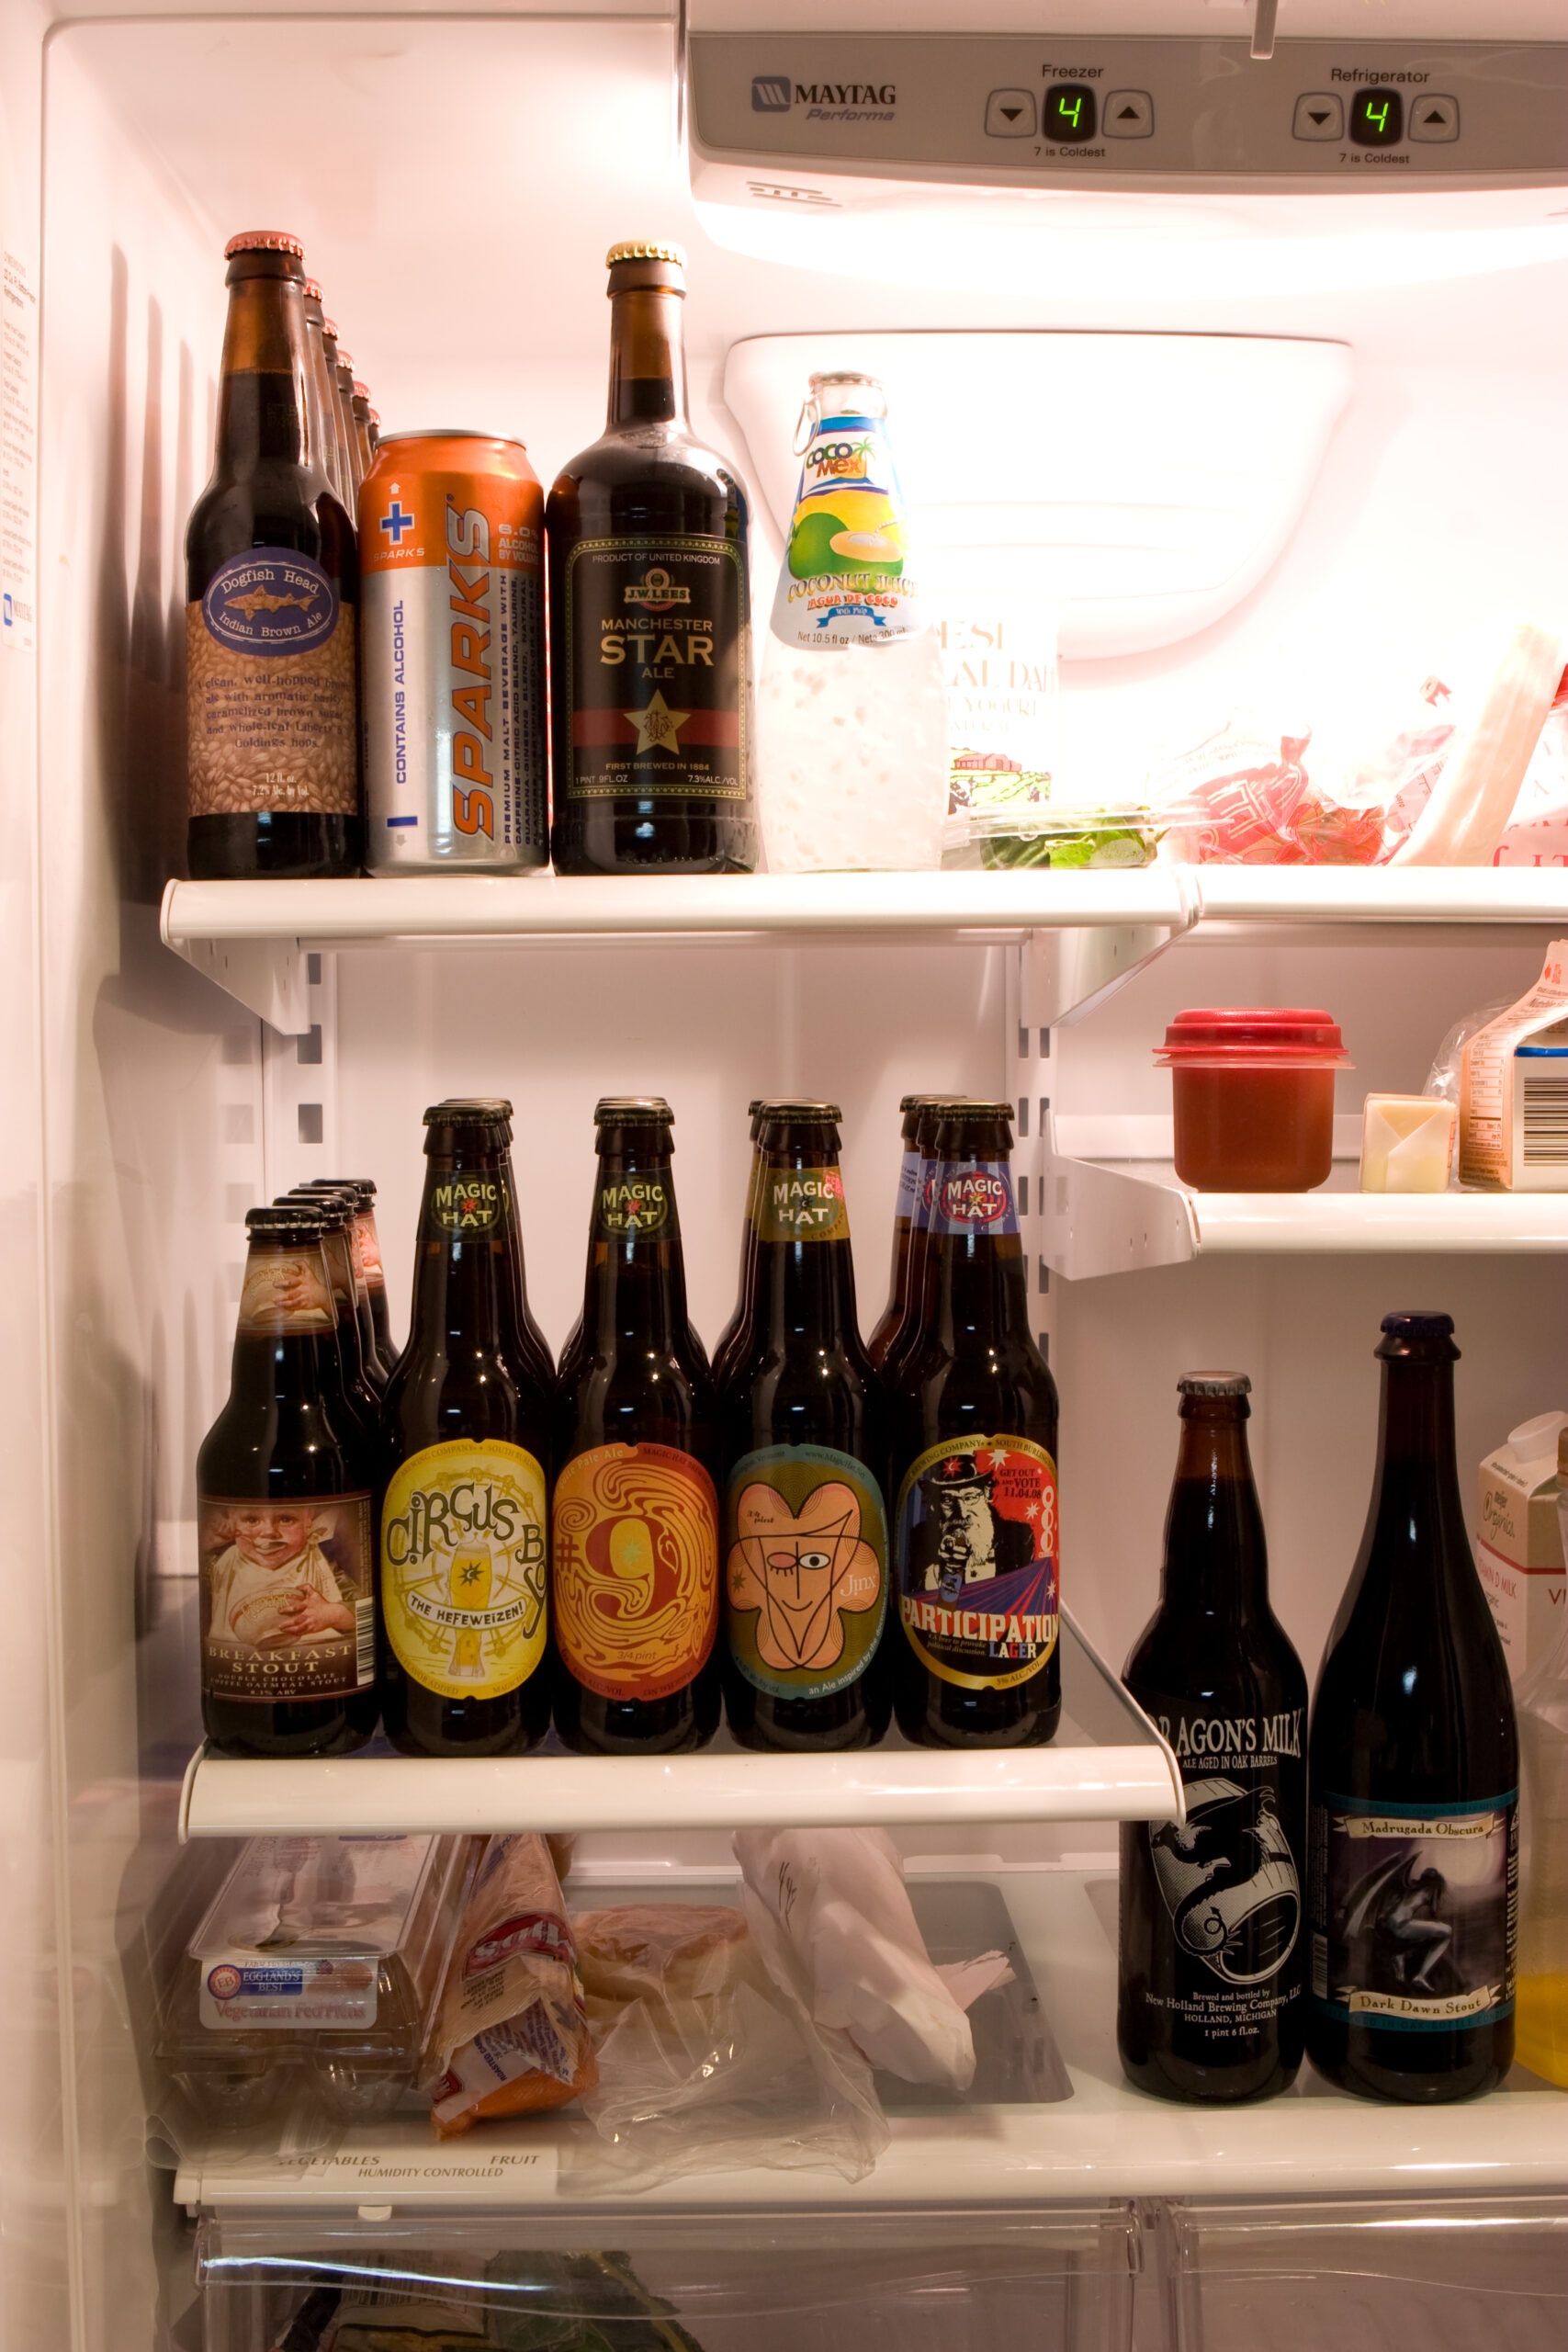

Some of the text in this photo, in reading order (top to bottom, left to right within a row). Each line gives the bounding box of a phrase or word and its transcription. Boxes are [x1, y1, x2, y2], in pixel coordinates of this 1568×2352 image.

[1042, 64, 1104, 79] Freezer
[1330, 69, 1430, 85] Refrigerator
[795, 85, 897, 104] MAYTAG
[806, 108, 896, 122] Performa
[1059, 97, 1082, 128] 4
[1366, 102, 1390, 132] 4
[1034, 146, 1105, 158] 7 is Coldest
[1339, 153, 1410, 164] 7 is Coldest
[374, 548, 426, 561] SPARKS
[499, 549, 511, 560] BY
[592, 553, 720, 565] PRODUCT OF UNITED KINGDOM
[221, 569, 320, 594] Dogfish Head
[787, 574, 871, 604] COCONUT
[808, 594, 898, 607] AGUA DE COCO
[219, 611, 322, 637] Indian Brown Ale
[601, 618, 713, 632] MANCHESTER
[798, 631, 850, 644] Net 10.5 fl oz
[600, 634, 715, 666] STAR
[446, 503, 496, 841] SPARKS
[501, 623, 509, 709] BEVERAGE
[641, 667, 675, 679] ALE
[254, 691, 309, 701] aromatic
[393, 599, 408, 784] CONTAINS ALCOHOL
[206, 707, 313, 719] caramelized brown
[502, 718, 511, 761] MALT
[690, 763, 710, 771] 1884
[265, 773, 276, 783] 12
[503, 769, 512, 844] PREMIUM
[435, 1183, 497, 1207] MAGIC
[603, 1184, 663, 1208] MAGIC
[773, 1181, 834, 1205] MAGIC
[948, 1180, 1002, 1200] MAGIC
[779, 1208, 829, 1225] HAT
[953, 1203, 997, 1218] HAT
[442, 1211, 492, 1227] HAT
[607, 1212, 658, 1228] HAT
[940, 1439, 1023, 1455] COMPANY SOUTH
[577, 1448, 624, 1470] Pale Ale
[1014, 1478, 1040, 1487] VOTE
[840, 1574, 877, 1597] Jinx
[1501, 1575, 1517, 1599] MILK
[411, 1595, 525, 1626] THE HEFEWEIZEN!
[900, 1594, 1058, 1643] PARTICIPATION
[209, 1645, 352, 1661] BREAKFAST
[989, 1642, 1037, 1659] LAGER
[232, 1661, 320, 1674] STOUT
[809, 1686, 819, 1695] an
[822, 1682, 836, 1691] Ale
[838, 1662, 864, 1685] inspired
[863, 1654, 872, 1664] by
[263, 1672, 335, 1682] CHOCOLATE
[310, 1677, 346, 1686] STOUT
[1262, 1708, 1302, 1758] MILK
[1183, 1755, 1279, 1770] ALE AGED IN OAK BARRELS
[1361, 1822, 1484, 1836] Madrugada Obscura
[258, 1983, 284, 1992] BEST
[1193, 1989, 1270, 2001] Brewed and bottled by
[1145, 1984, 1302, 2014] New Holland Brewing Company, LLC
[1360, 1996, 1394, 2009] Dark
[1401, 1999, 1439, 2014] Dawn
[1446, 1998, 1481, 2014] Stout
[214, 2001, 293, 2021] Vegetarian
[295, 2003, 325, 2019] Fed
[1184, 2008, 1277, 2024] HOLLAND, MICHIGAN
[1212, 2029, 1229, 2040] pint
[491, 2155, 540, 2165] FRUIT
[358, 2167, 503, 2177] HUMIDITY CONTROLLED
